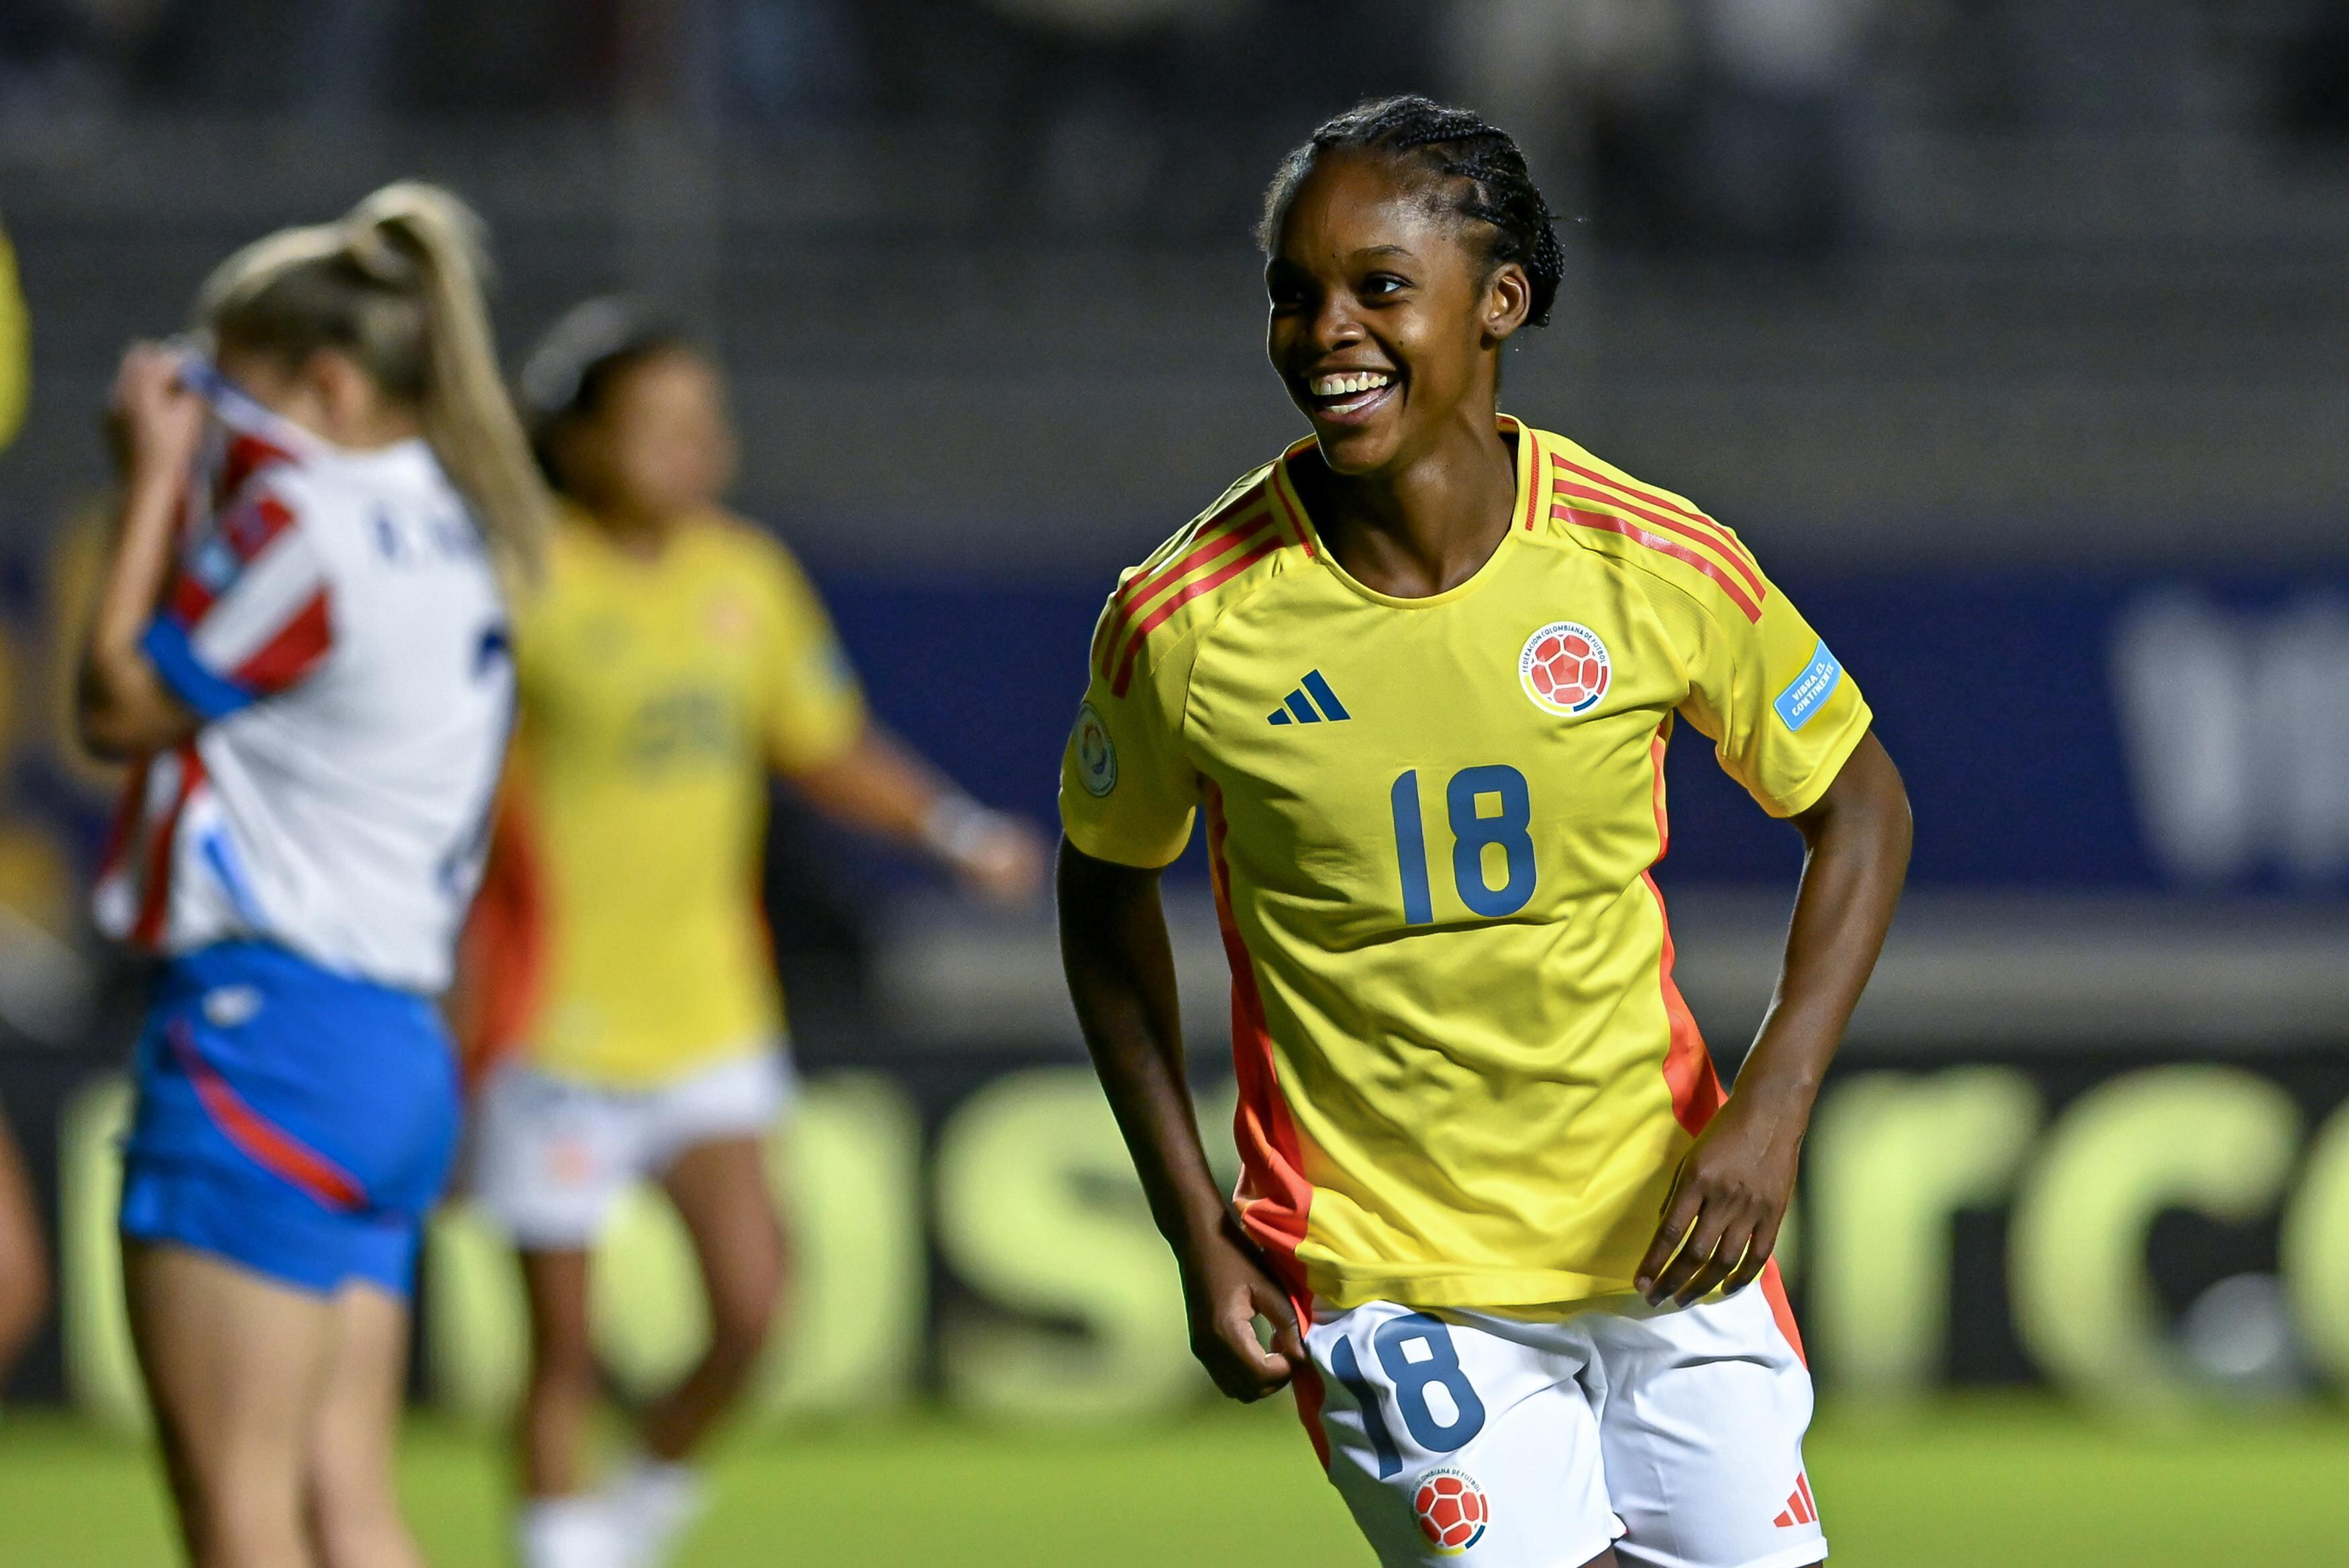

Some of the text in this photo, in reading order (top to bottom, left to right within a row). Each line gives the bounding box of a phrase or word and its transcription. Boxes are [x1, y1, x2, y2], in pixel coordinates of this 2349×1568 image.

[1542, 625, 1584, 637] COLOMBIANA
[1584, 632, 1592, 641] DE
[1591, 638, 1606, 663] FUTBOL
[1791, 662, 1834, 717] CONTINENTE
[1792, 662, 1826, 701] VIBRA EL
[1391, 764, 1537, 925] 18
[1331, 1312, 1485, 1481] 18
[1460, 1472, 1482, 1492] FUTBOL
